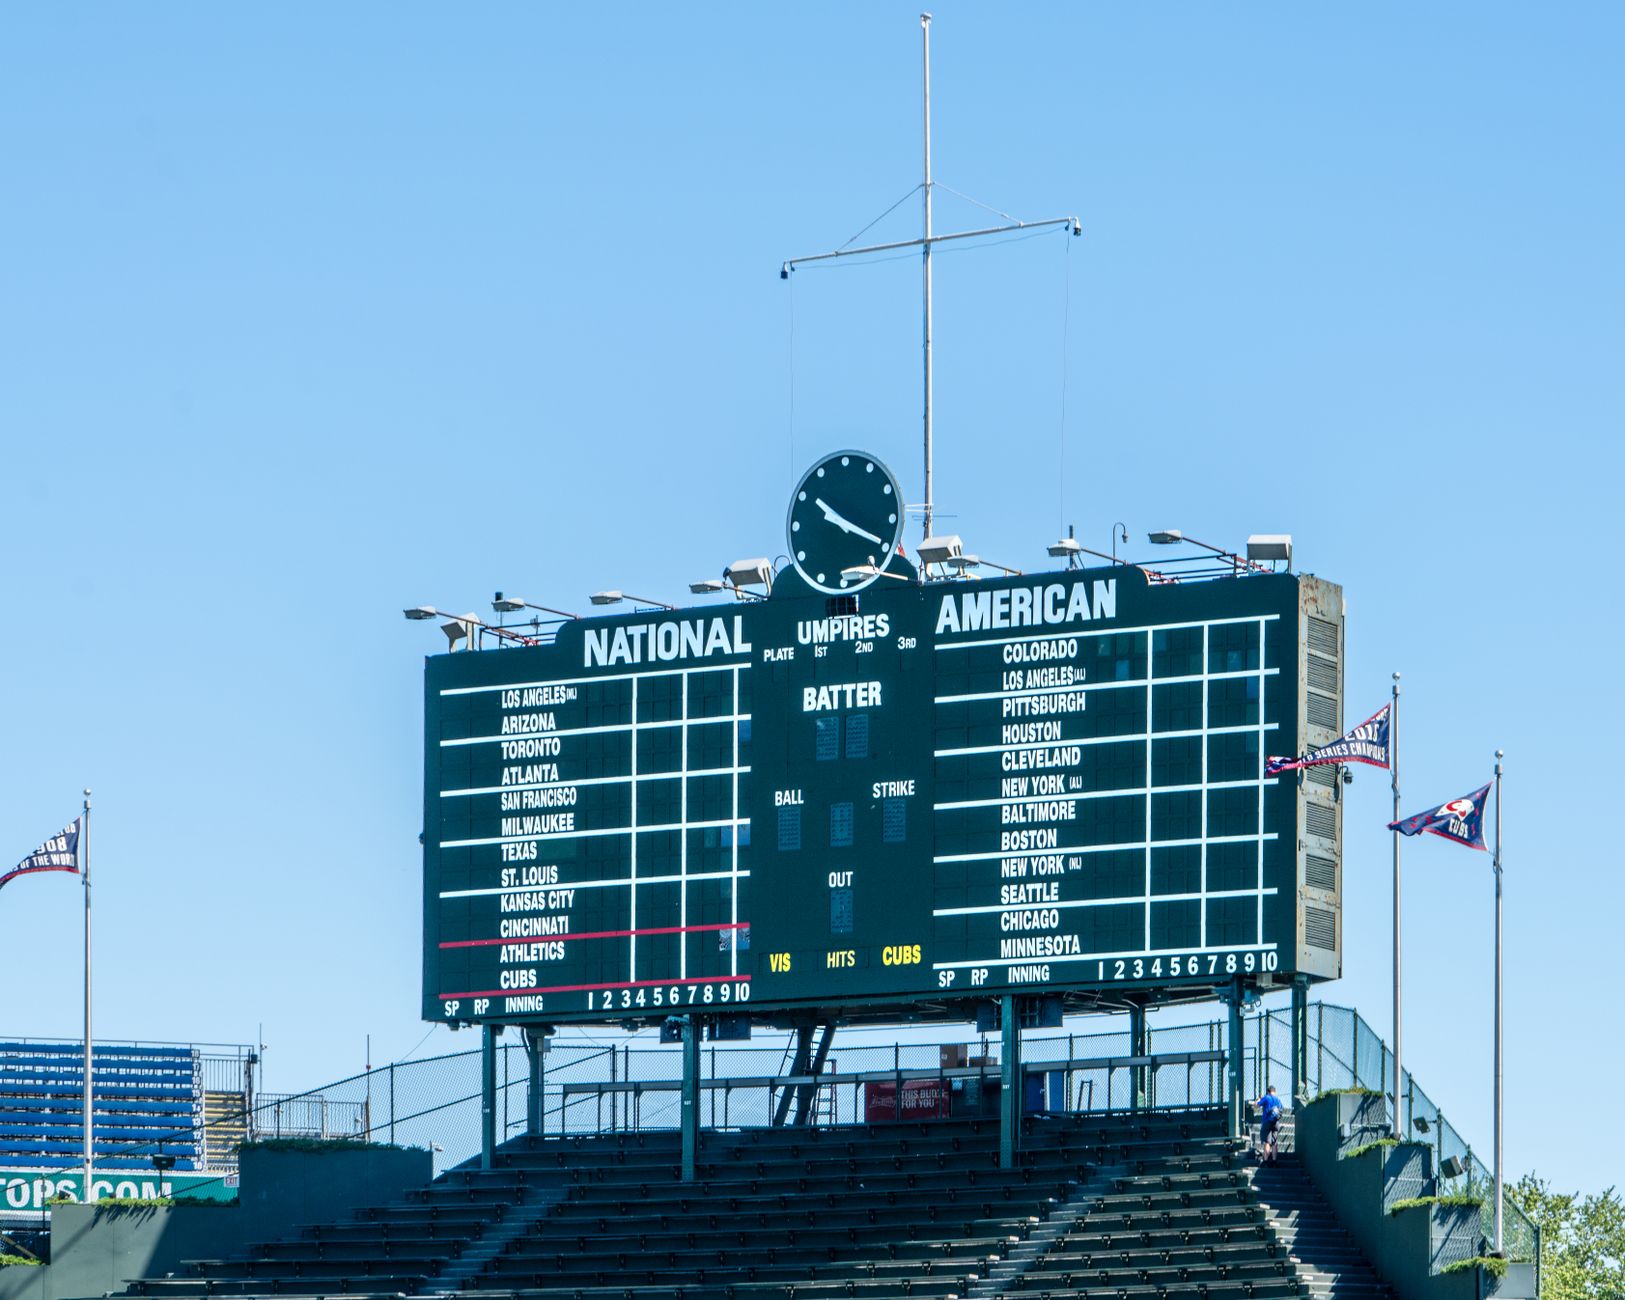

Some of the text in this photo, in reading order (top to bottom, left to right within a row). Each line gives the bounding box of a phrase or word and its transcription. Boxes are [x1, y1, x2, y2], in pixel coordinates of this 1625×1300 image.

[934, 578, 1116, 635] AMERICAN
[797, 613, 890, 645] UMPIRES
[584, 615, 752, 667] NATIONAL
[764, 636, 916, 662] PLATE 1ST 2ND 3RD
[1003, 639, 1077, 664] COLORADO
[1003, 670, 1023, 690] LOS
[502, 690, 520, 708] LOS
[803, 681, 881, 711] BATTER
[1003, 692, 1085, 717] PITTSBURGH
[502, 712, 556, 734] ARIZONA
[1003, 721, 1061, 744] HOUSTON
[501, 737, 560, 759] TORONTO
[1002, 747, 1081, 771] CLEVELAND
[1315, 743, 1348, 760] SERIES
[502, 763, 559, 785] ATLANTA
[1002, 774, 1082, 797] NEW YORK (AL)
[501, 787, 577, 811] SAN FRANCISCO
[775, 789, 804, 806] BALL
[873, 780, 915, 798] STRIKE
[1002, 800, 1076, 824] BALTIMORE
[502, 813, 574, 836] MILWAUKEE
[501, 841, 537, 861] TEXAS
[1001, 828, 1057, 851] BOSTON
[32, 855, 50, 867] THE
[1001, 855, 1082, 878] NEW YORK (NL)
[501, 865, 558, 887] ST. LOUIS
[829, 871, 853, 887] OUT
[501, 890, 575, 912] KANSAS CITY
[1001, 882, 1059, 904] SEATTLE
[500, 915, 568, 938] CINCINNATI
[1001, 909, 1059, 931] CHICAGO
[500, 941, 565, 963] ATHLETICS
[770, 944, 921, 972] VIS HITS CUBS
[1001, 935, 1080, 958] MINNESOTA
[500, 969, 537, 989] CUBS
[939, 952, 1277, 987] SP RP INNING 1 2 3 4 5 6 7 8 9 10
[445, 983, 750, 1016] SP RP INNING 1 2 3 4 5 6 7 8 9 10
[901, 1089, 918, 1100] THIS
[901, 1099, 917, 1109] FOR
[919, 1099, 935, 1108] YOU
[0, 1178, 172, 1208] OPSCOM
